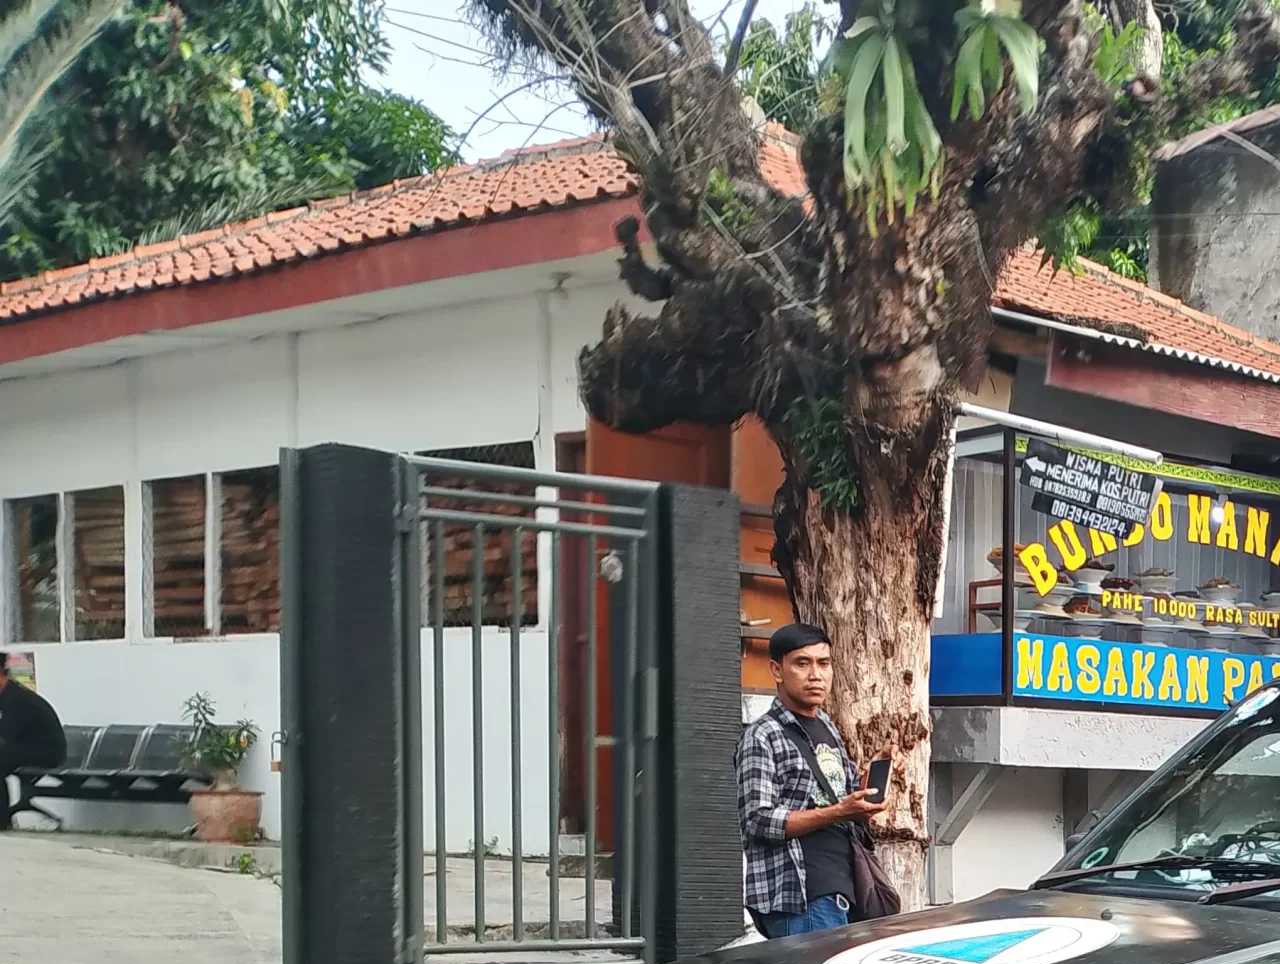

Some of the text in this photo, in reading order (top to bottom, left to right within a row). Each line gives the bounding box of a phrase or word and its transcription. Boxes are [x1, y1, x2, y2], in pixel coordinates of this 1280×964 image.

[1046, 463, 1099, 493] MENERIMA
[1066, 452, 1143, 490] WISMA PUTRI
[1102, 589, 1143, 612] PAHE
[1153, 598, 1196, 619] 10000
[1206, 604, 1243, 624] RASA
[1017, 637, 1209, 703] MASAKAN
